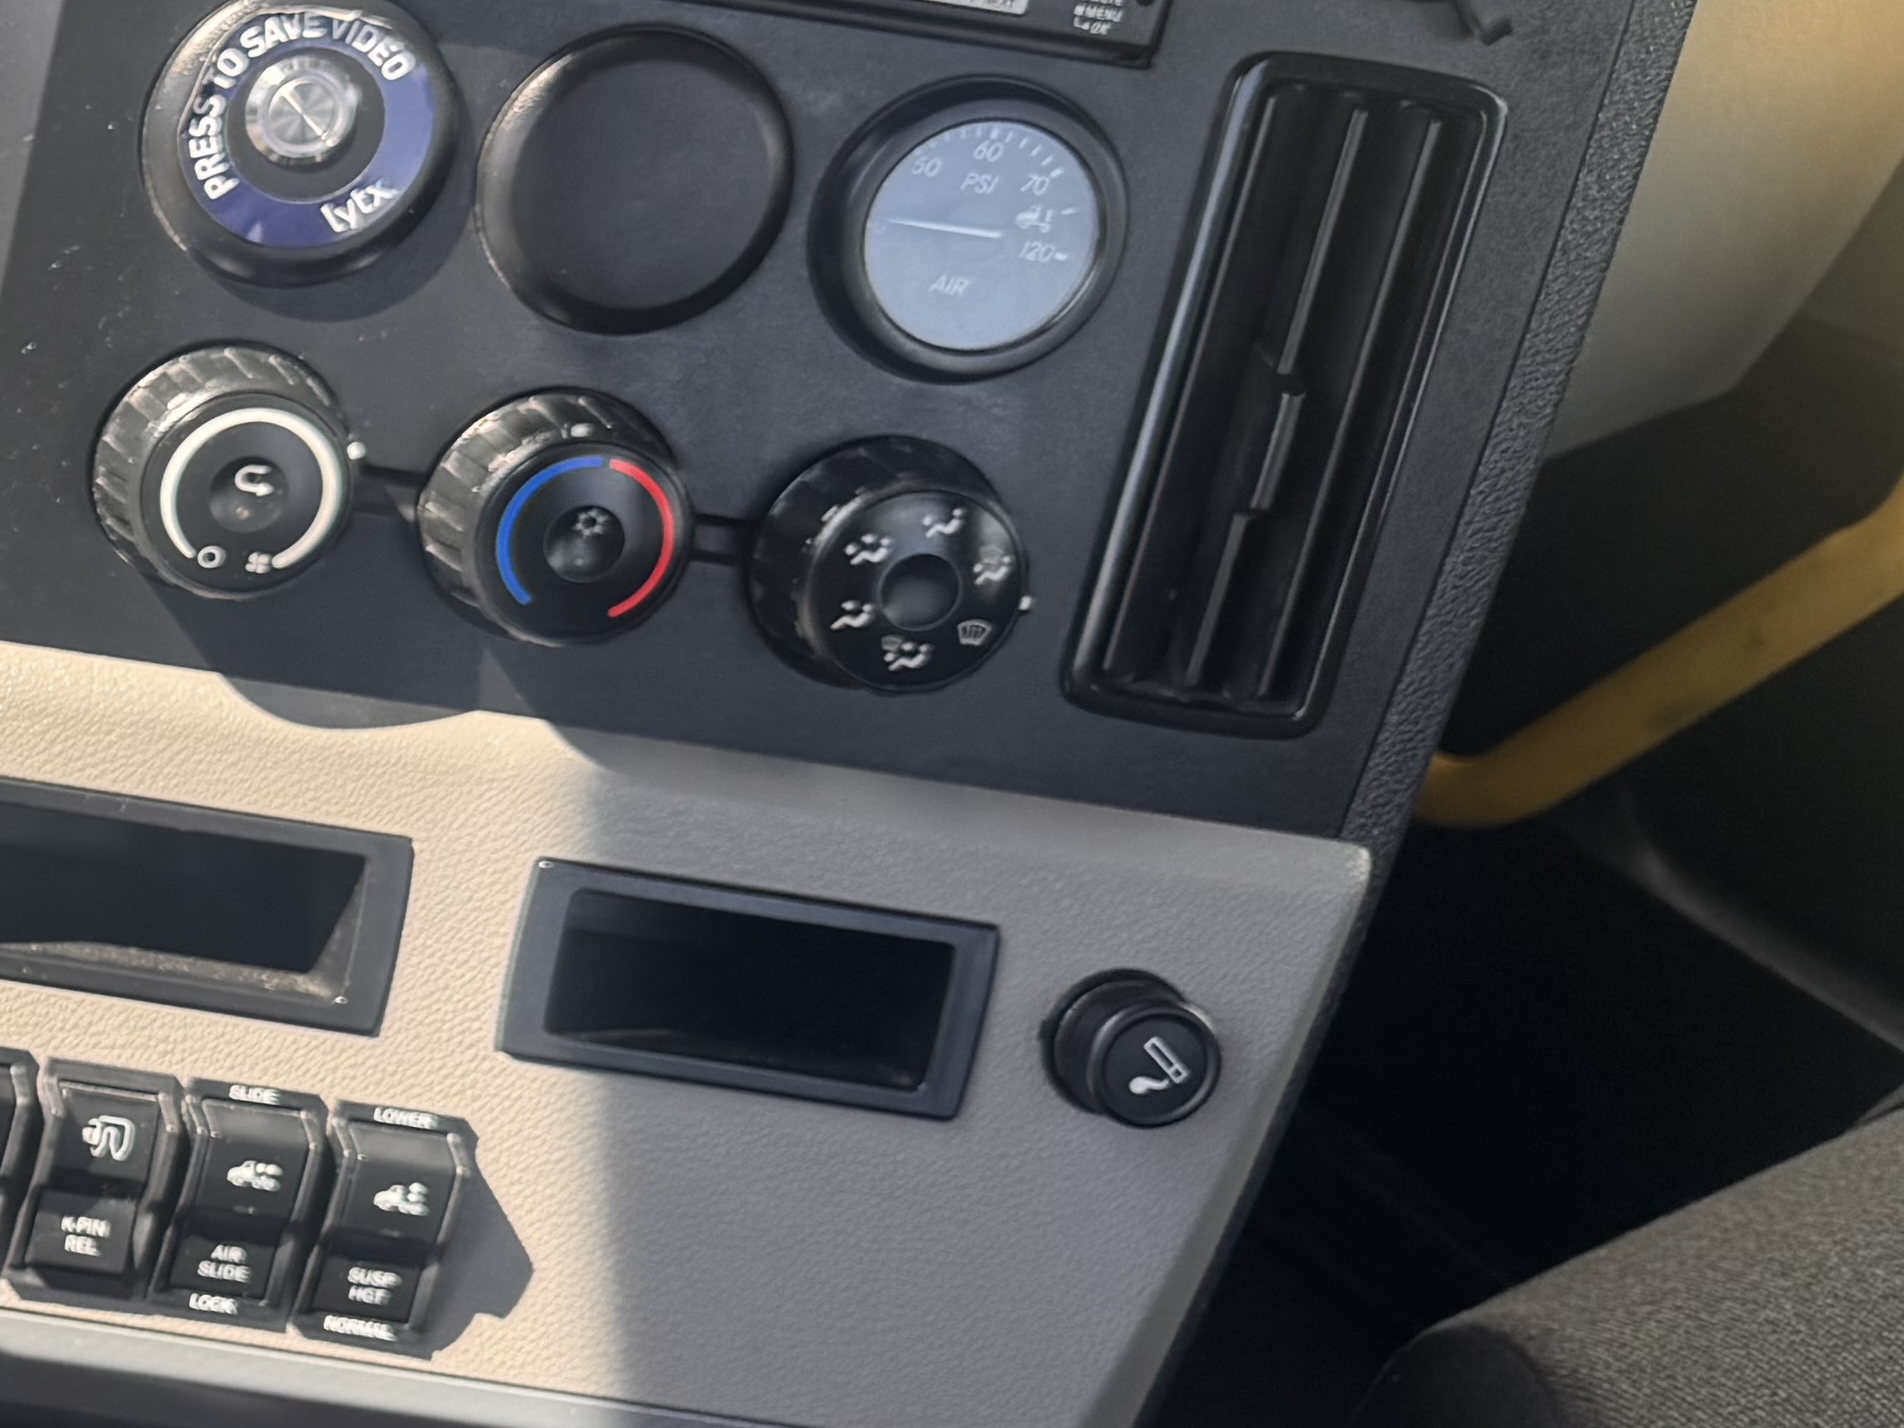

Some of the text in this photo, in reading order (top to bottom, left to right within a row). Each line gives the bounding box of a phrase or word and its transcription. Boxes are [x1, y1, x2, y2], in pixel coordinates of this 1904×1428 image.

[1089, 3, 1125, 22] MENU
[188, 13, 416, 200] PRESS TO SAVE VIDEO
[973, 140, 1005, 163] 60
[960, 172, 1000, 194] PSI
[1020, 174, 1050, 197] 70
[1018, 241, 1055, 263] 120
[929, 274, 970, 296] AIR
[229, 1084, 281, 1106] SLIDE
[373, 1106, 439, 1130] LOWER
[210, 1243, 248, 1264] AIR
[197, 1259, 252, 1284] SLIDE
[189, 1292, 239, 1316] LOCK
